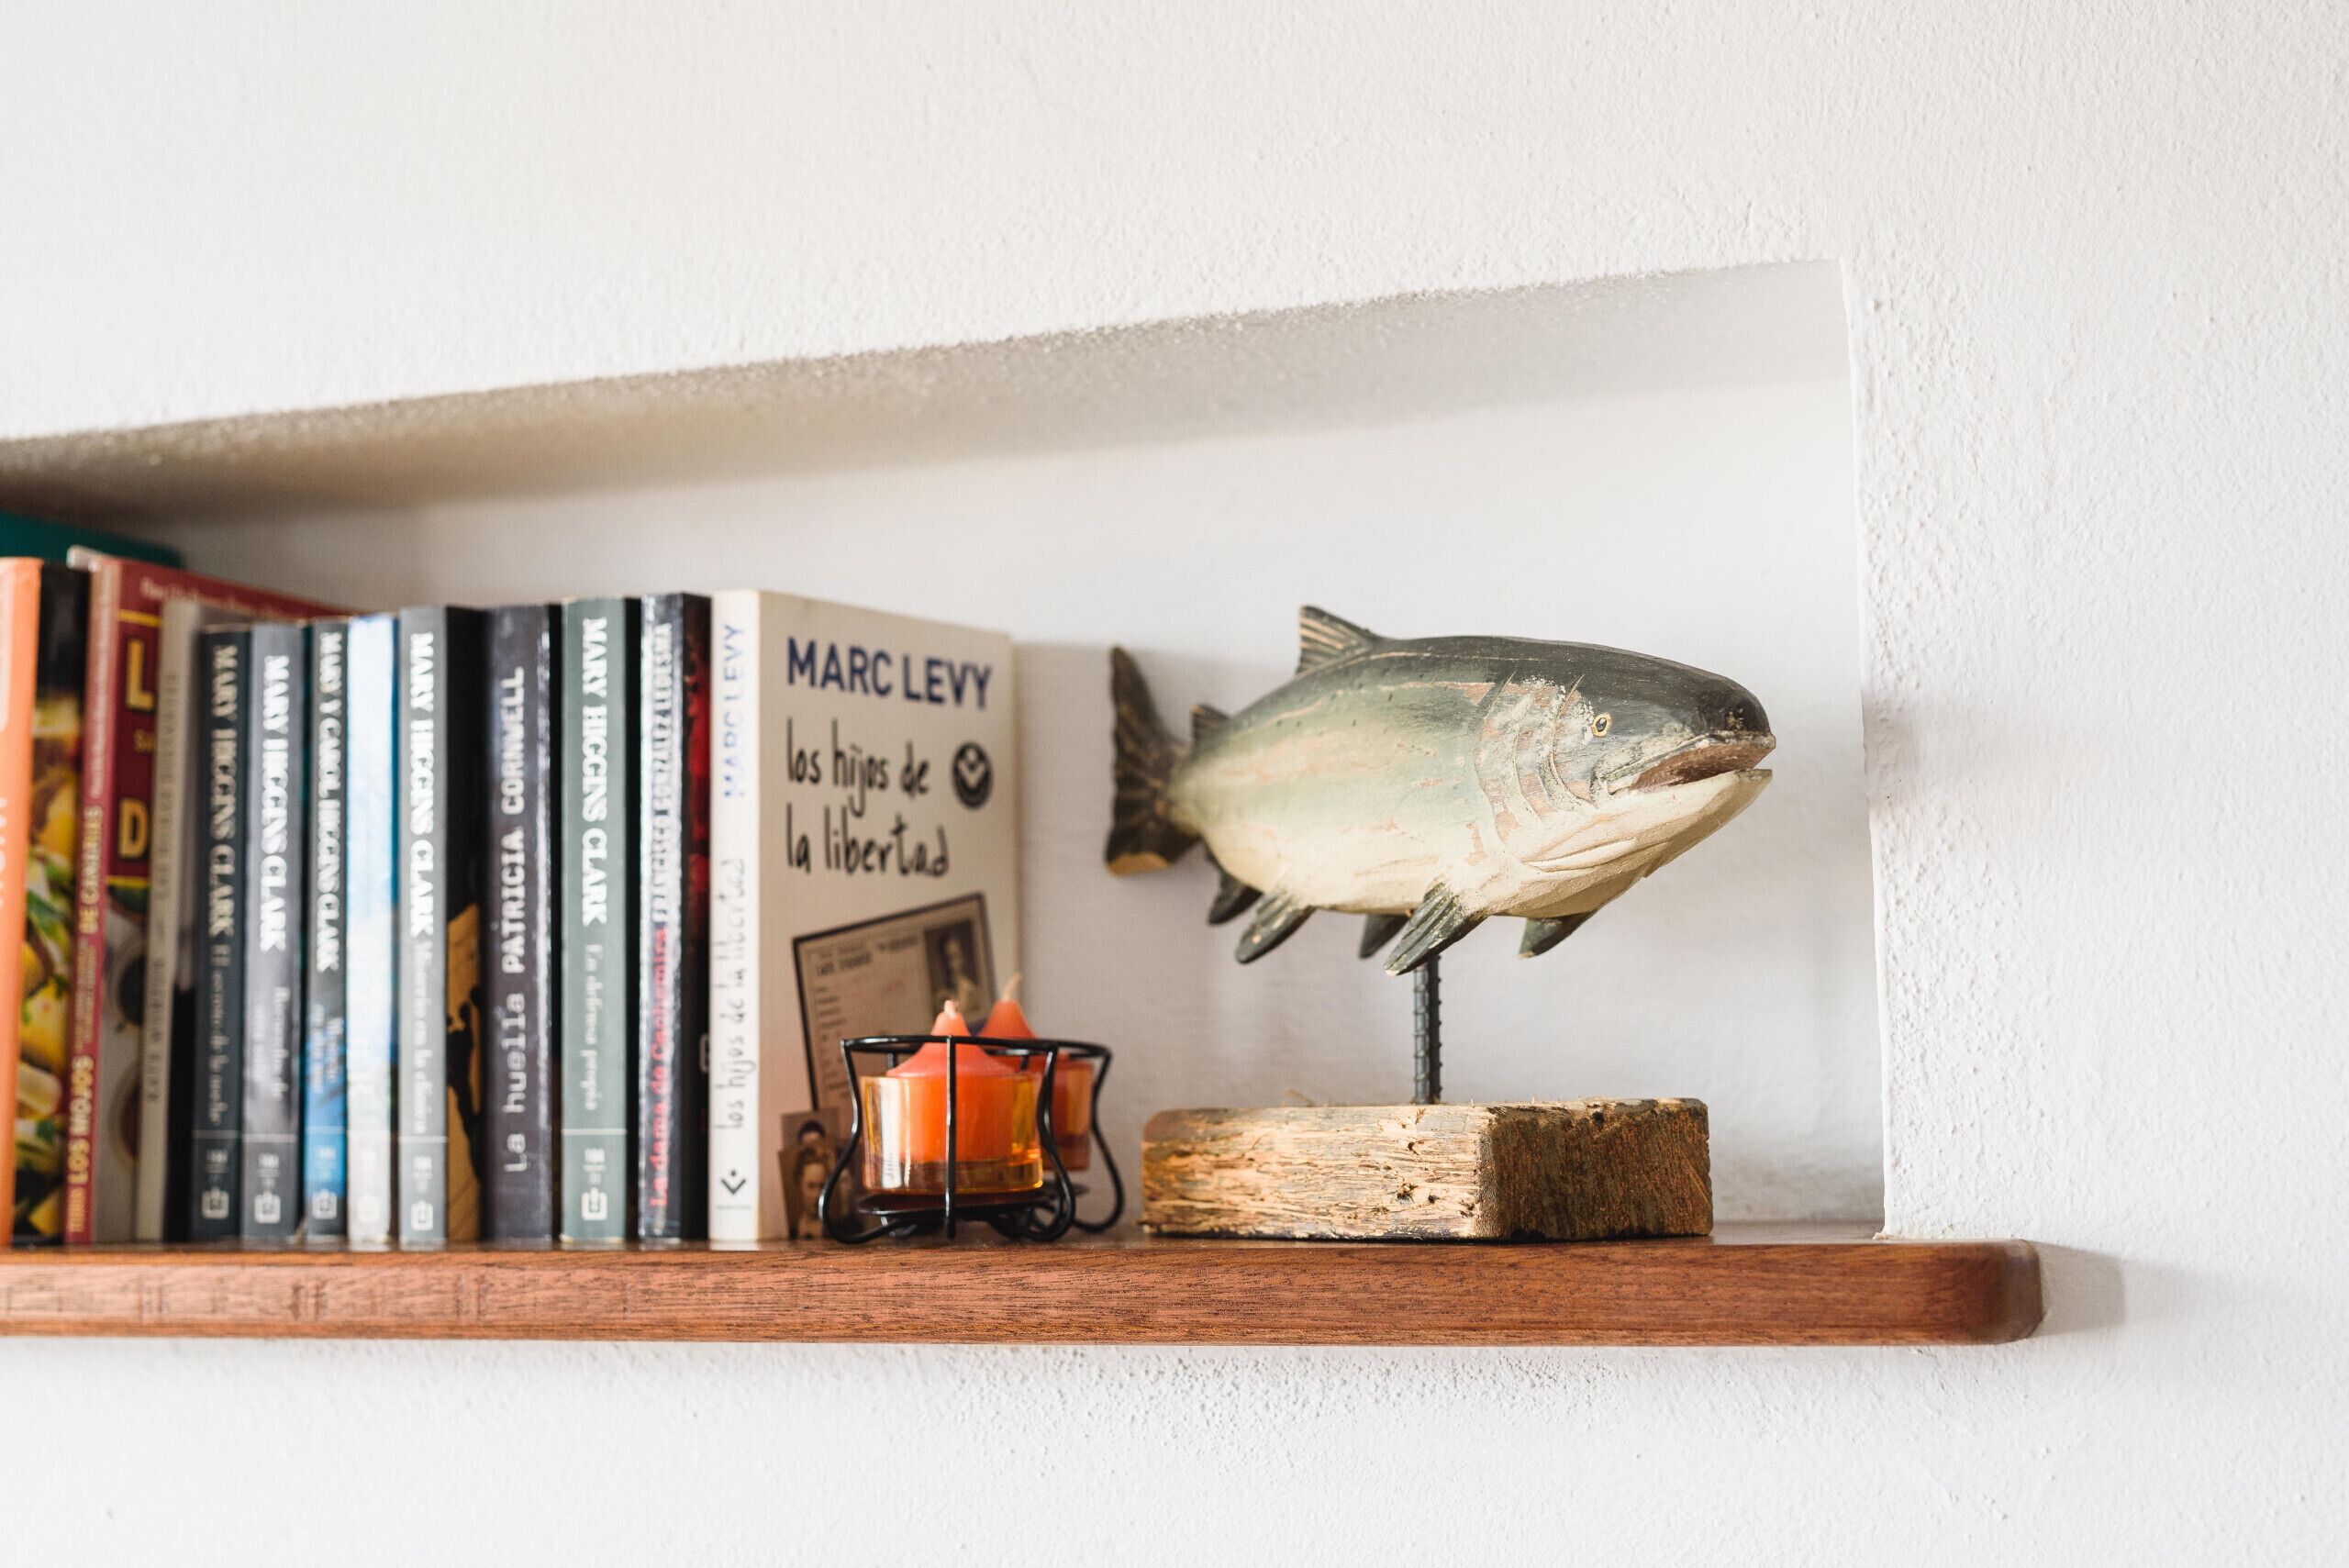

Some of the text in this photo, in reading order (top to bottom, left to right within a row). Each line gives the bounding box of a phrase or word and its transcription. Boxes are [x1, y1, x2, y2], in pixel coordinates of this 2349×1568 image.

[721, 624, 745, 798] MARC LEVY
[786, 636, 993, 711] MARC LEVY
[208, 645, 239, 937] MARY HIGGINS CLARK
[260, 656, 290, 951] MARY HIGGINS CLARK
[317, 632, 343, 973] MARY Y CAROL HIGGINS CLARK
[409, 633, 434, 937] MARY HIGGINS CLARK
[582, 617, 607, 927] MARY HIGGINS CLARK
[786, 716, 930, 818] los hijos de
[786, 801, 950, 878] la libertad
[501, 667, 528, 1173] La huella PATRICIA CORNWELL
[69, 1055, 95, 1136] MOJOS
[649, 928, 668, 1207] La dama de Cachemira
[712, 1038, 757, 1090] hijos
[712, 1101, 745, 1129] los
[67, 1139, 90, 1185] LOS
